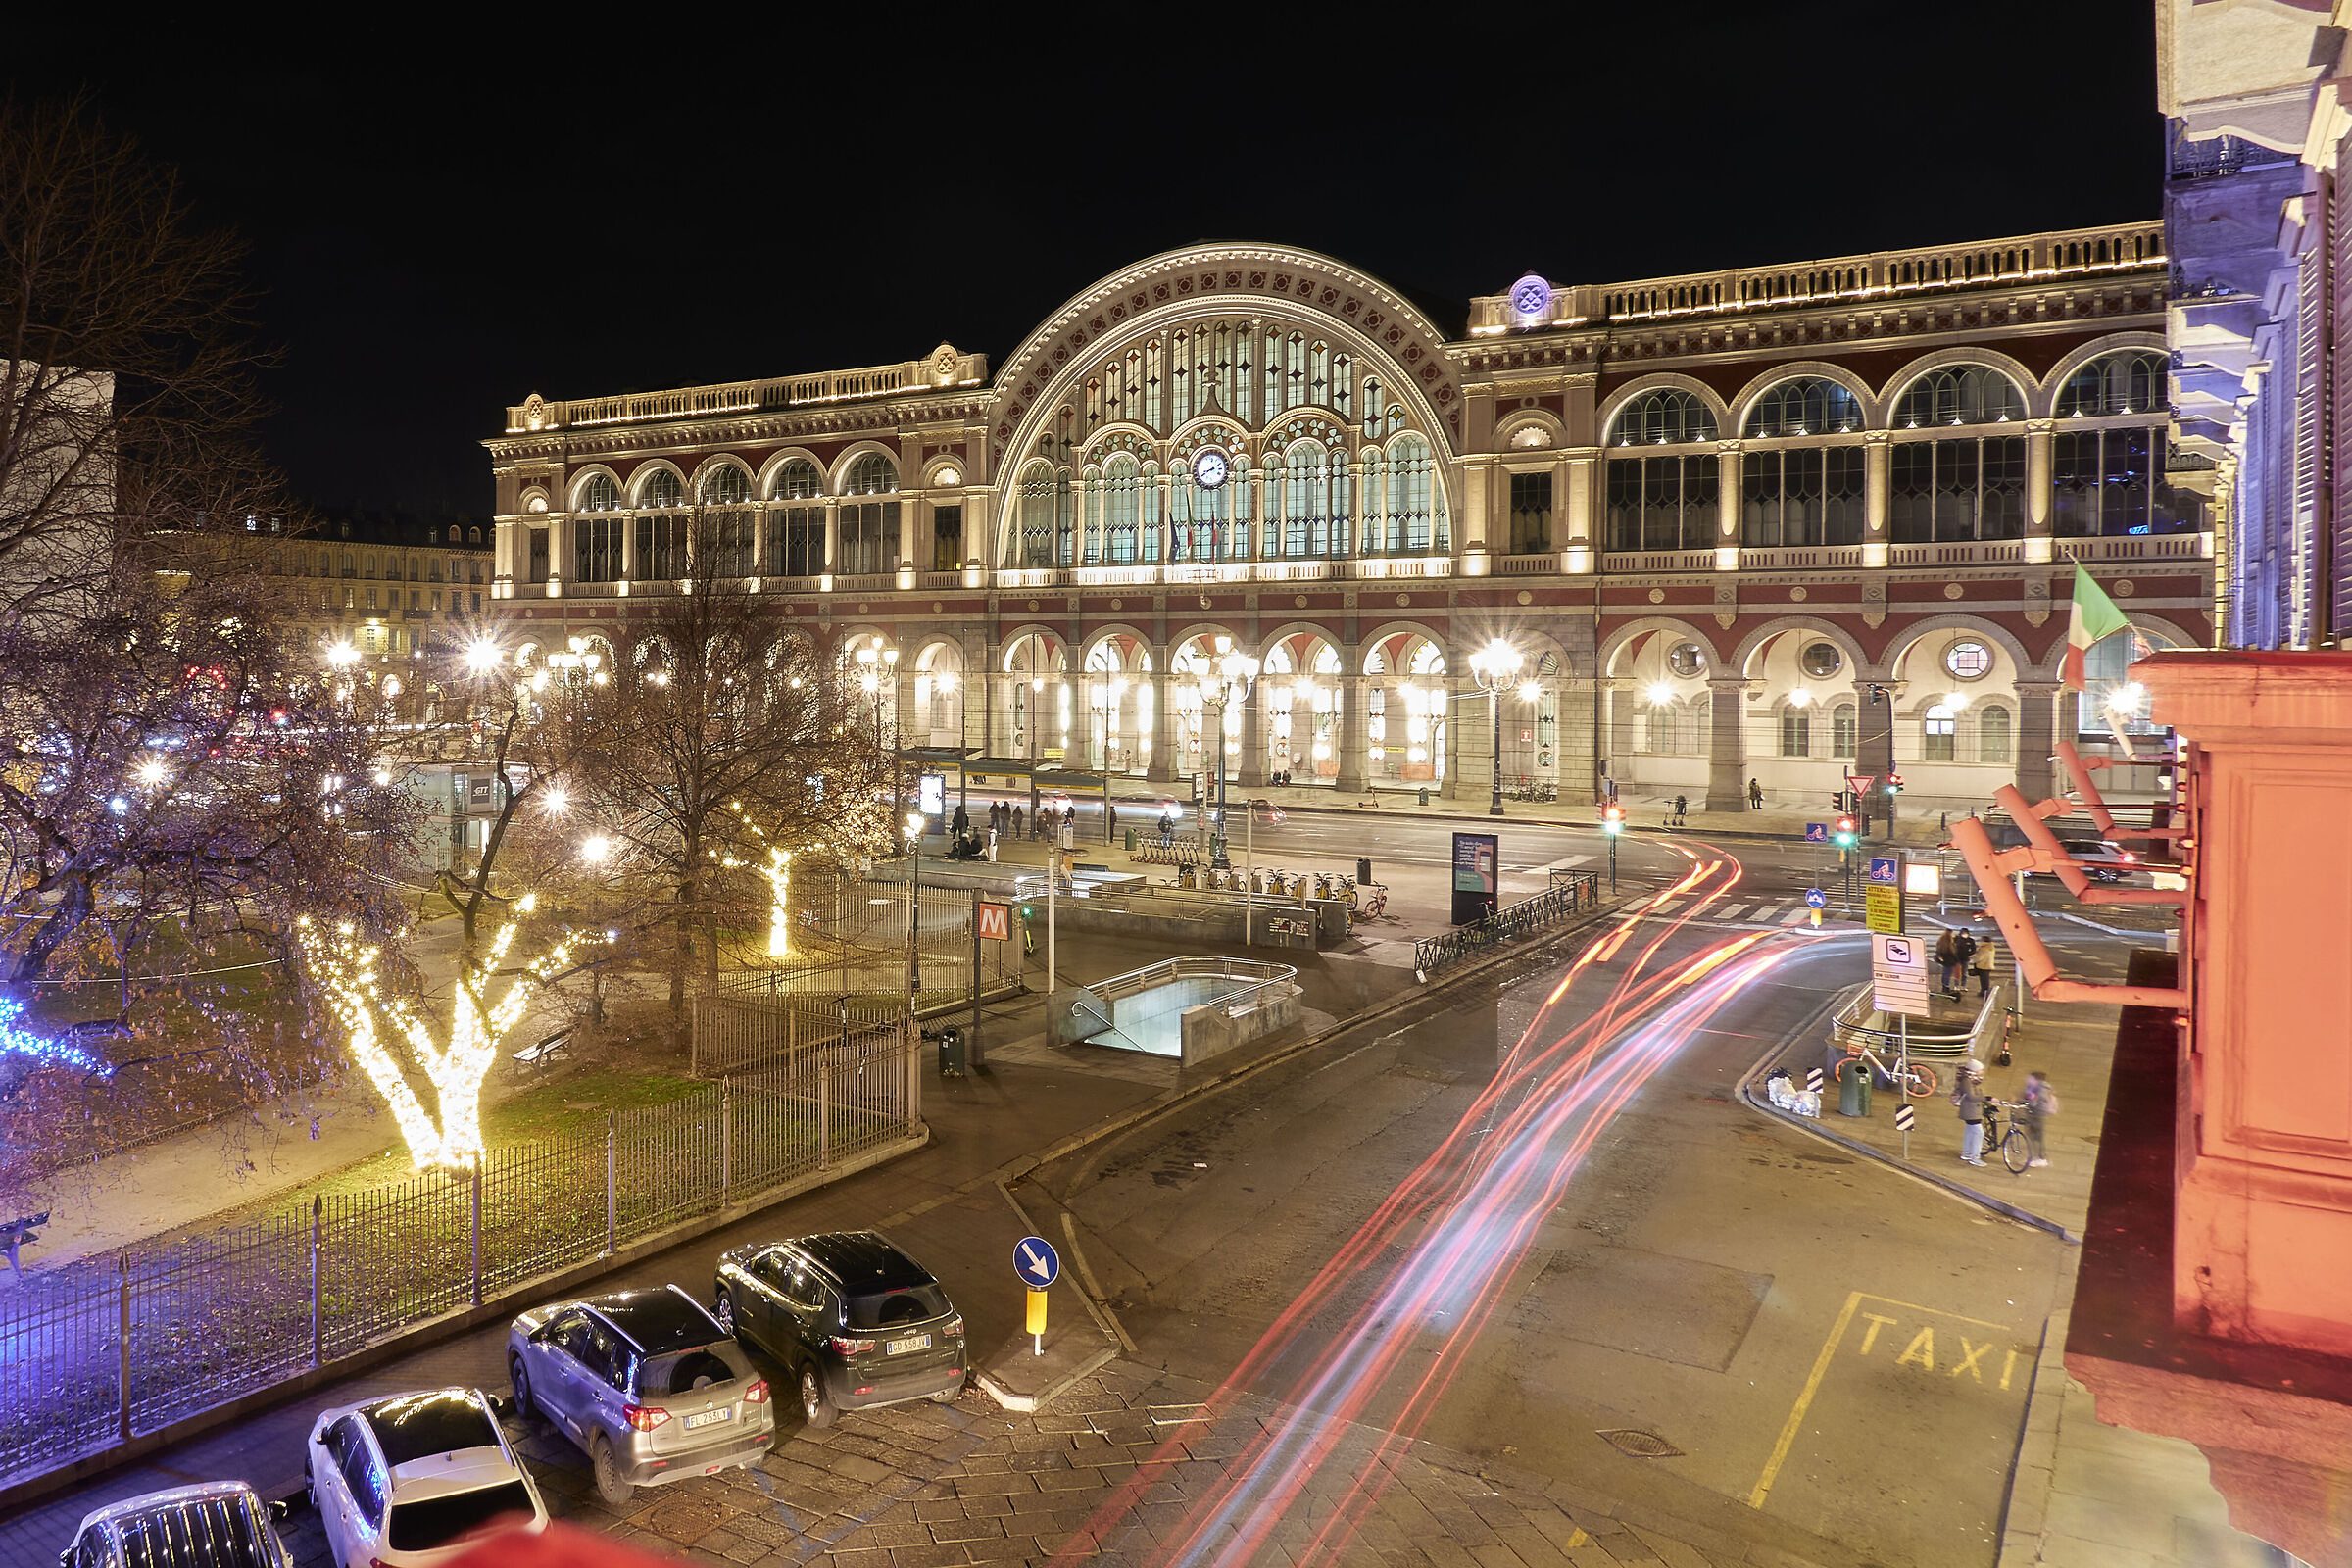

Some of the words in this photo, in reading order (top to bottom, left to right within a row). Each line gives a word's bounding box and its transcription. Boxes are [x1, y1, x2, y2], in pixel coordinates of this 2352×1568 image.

[981, 908, 1007, 935] M
[1860, 1312, 2017, 1391] TAXI
[691, 1417, 700, 1426] FL
[704, 1410, 727, 1423] 253LY
